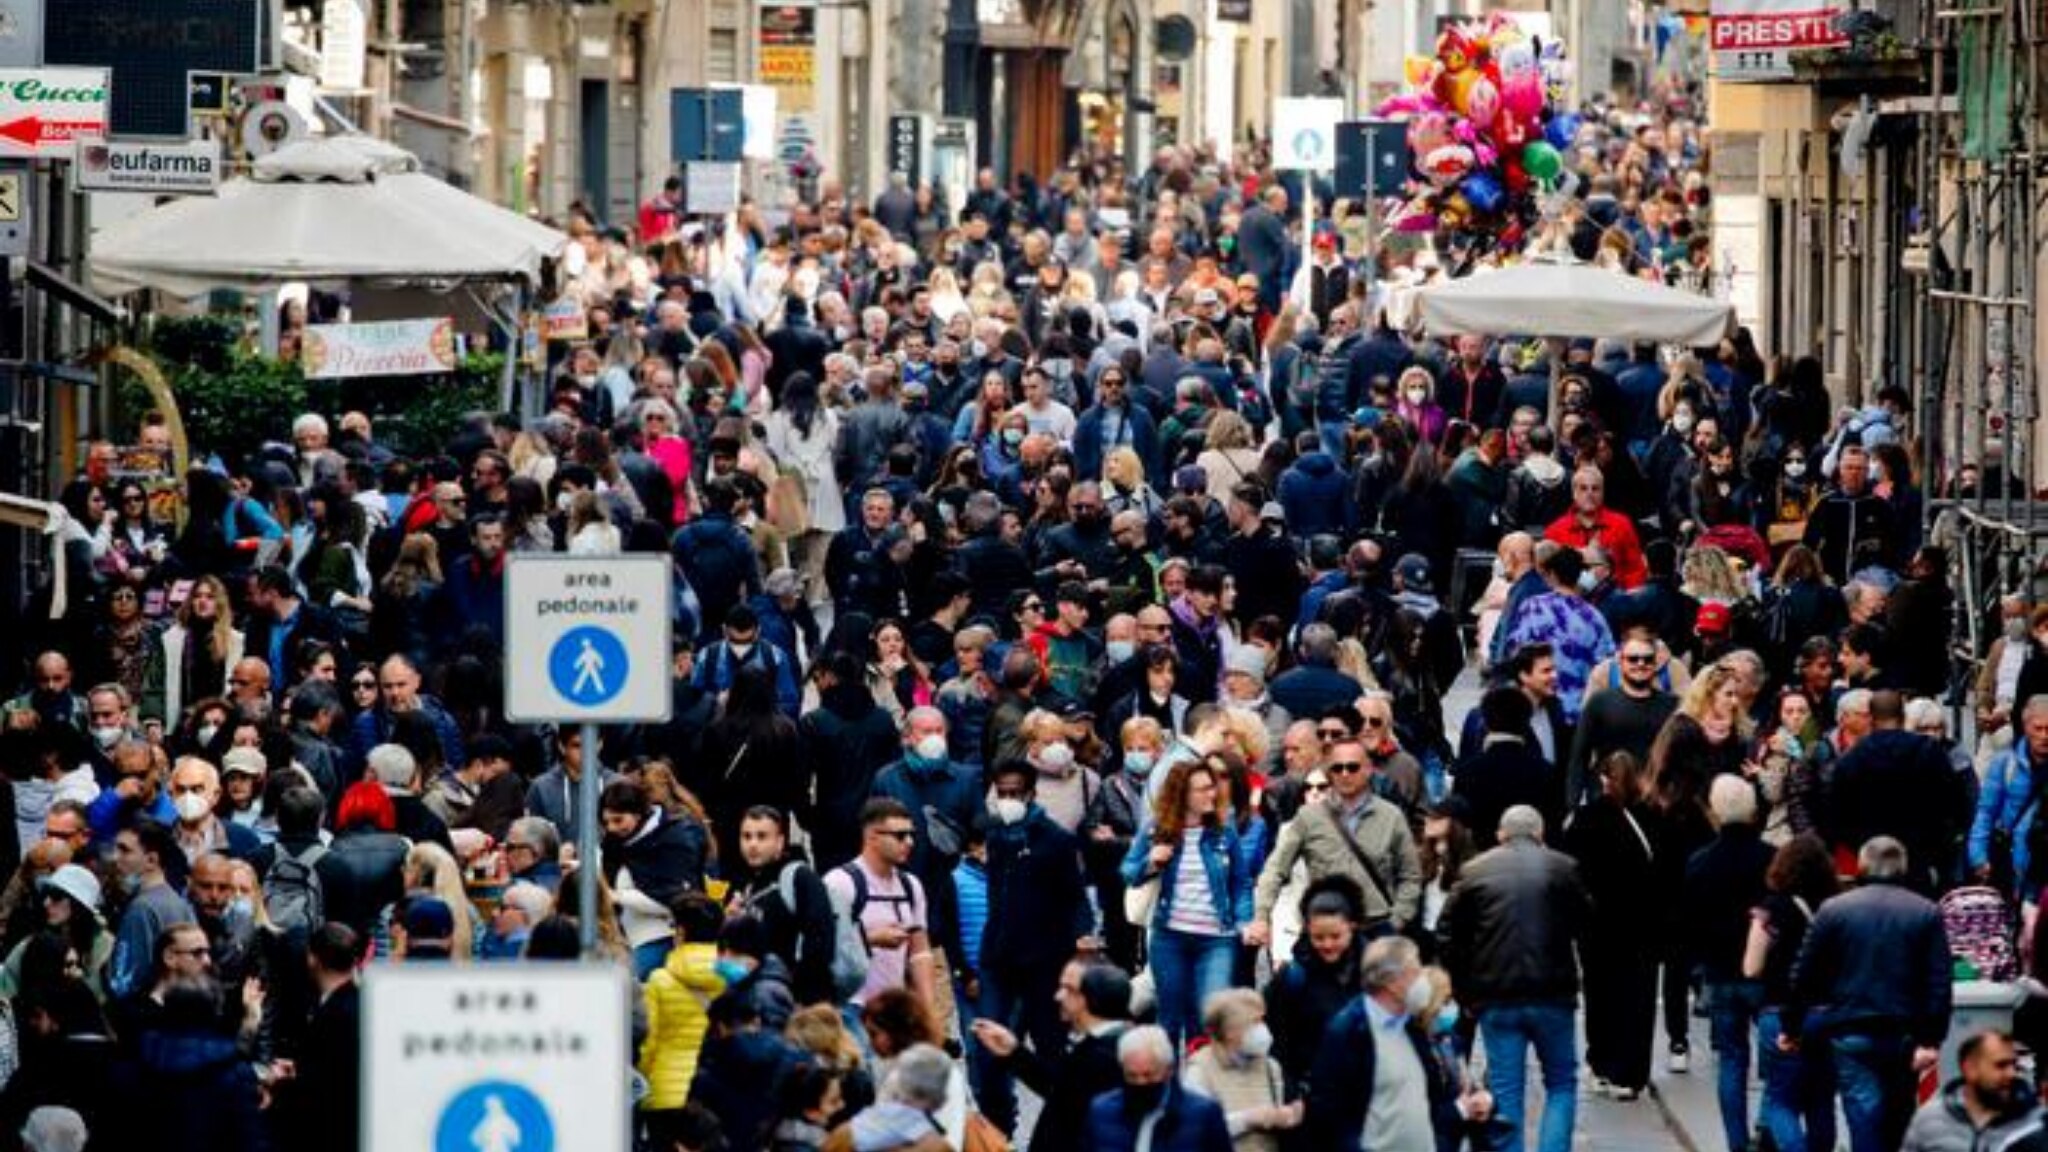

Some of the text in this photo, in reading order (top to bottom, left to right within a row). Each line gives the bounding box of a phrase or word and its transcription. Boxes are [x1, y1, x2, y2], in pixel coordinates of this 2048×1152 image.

[109, 148, 212, 173] eufarma
[564, 573, 612, 588] area
[537, 595, 639, 616] pedonale
[454, 989, 537, 1013] area
[402, 1029, 586, 1060] pedonale
